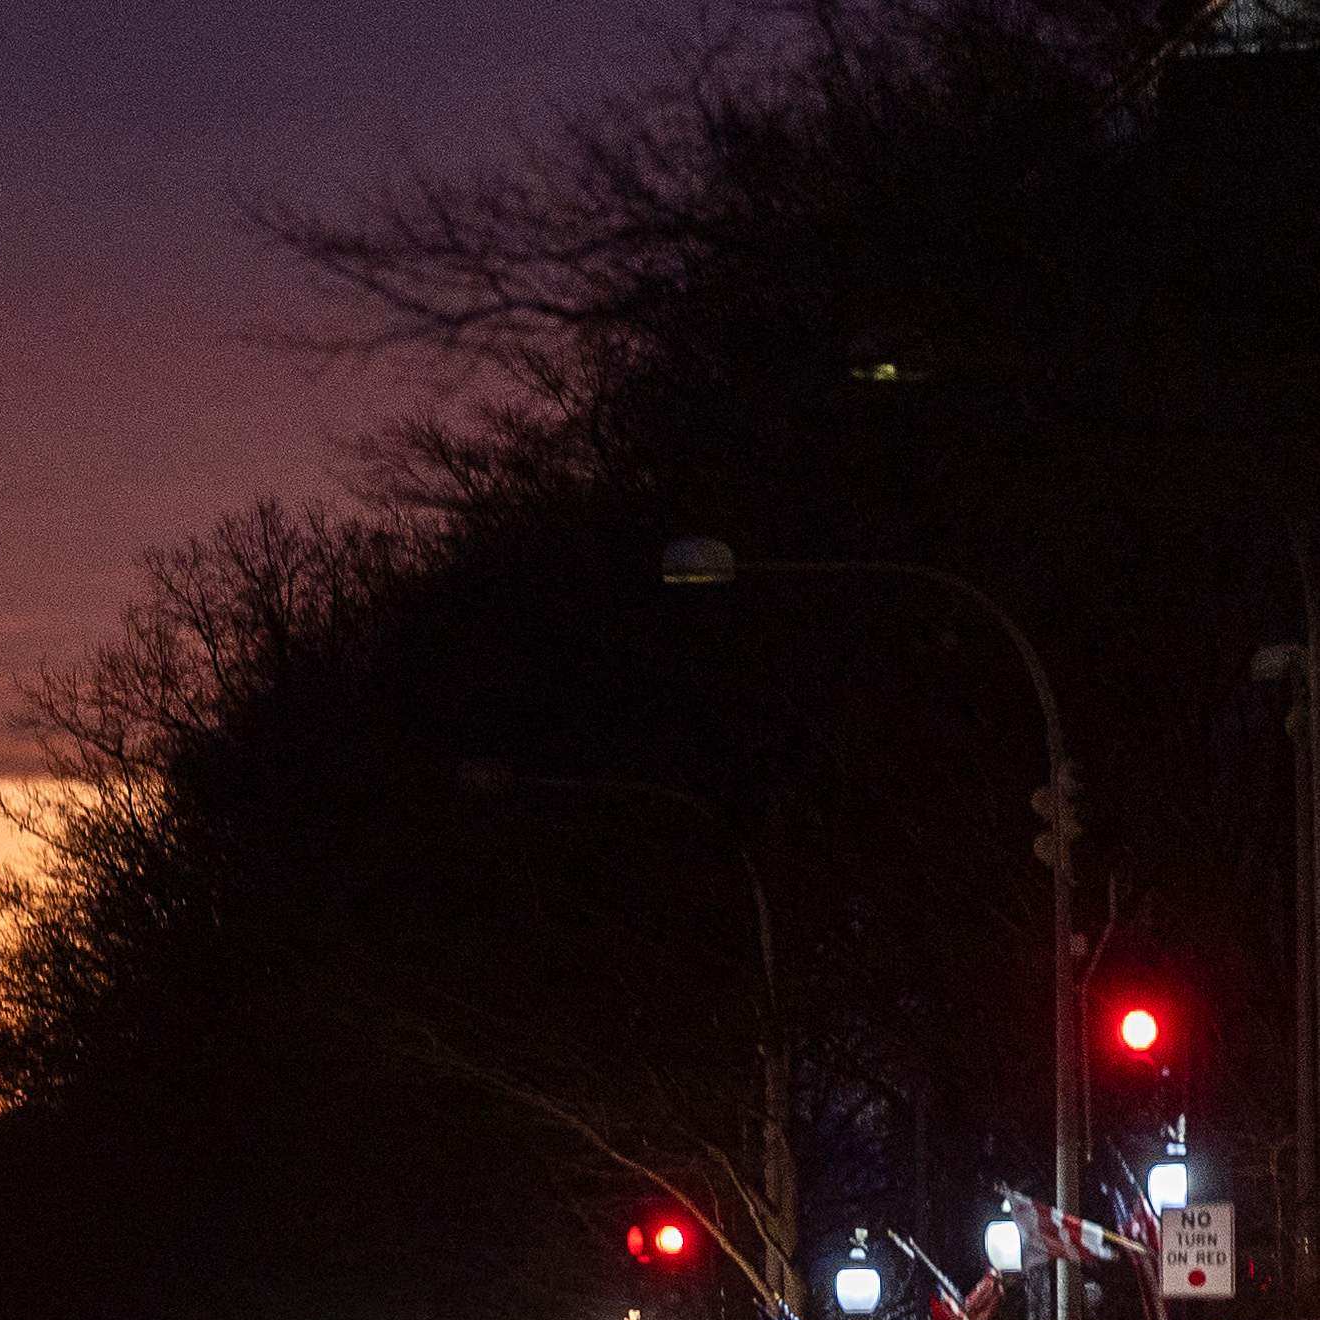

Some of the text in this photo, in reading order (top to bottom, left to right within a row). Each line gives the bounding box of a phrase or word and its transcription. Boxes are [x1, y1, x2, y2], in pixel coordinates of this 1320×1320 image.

[1181, 1208, 1212, 1229] NO
[1176, 1231, 1218, 1248] TURN
[1167, 1250, 1227, 1265] ON RED
